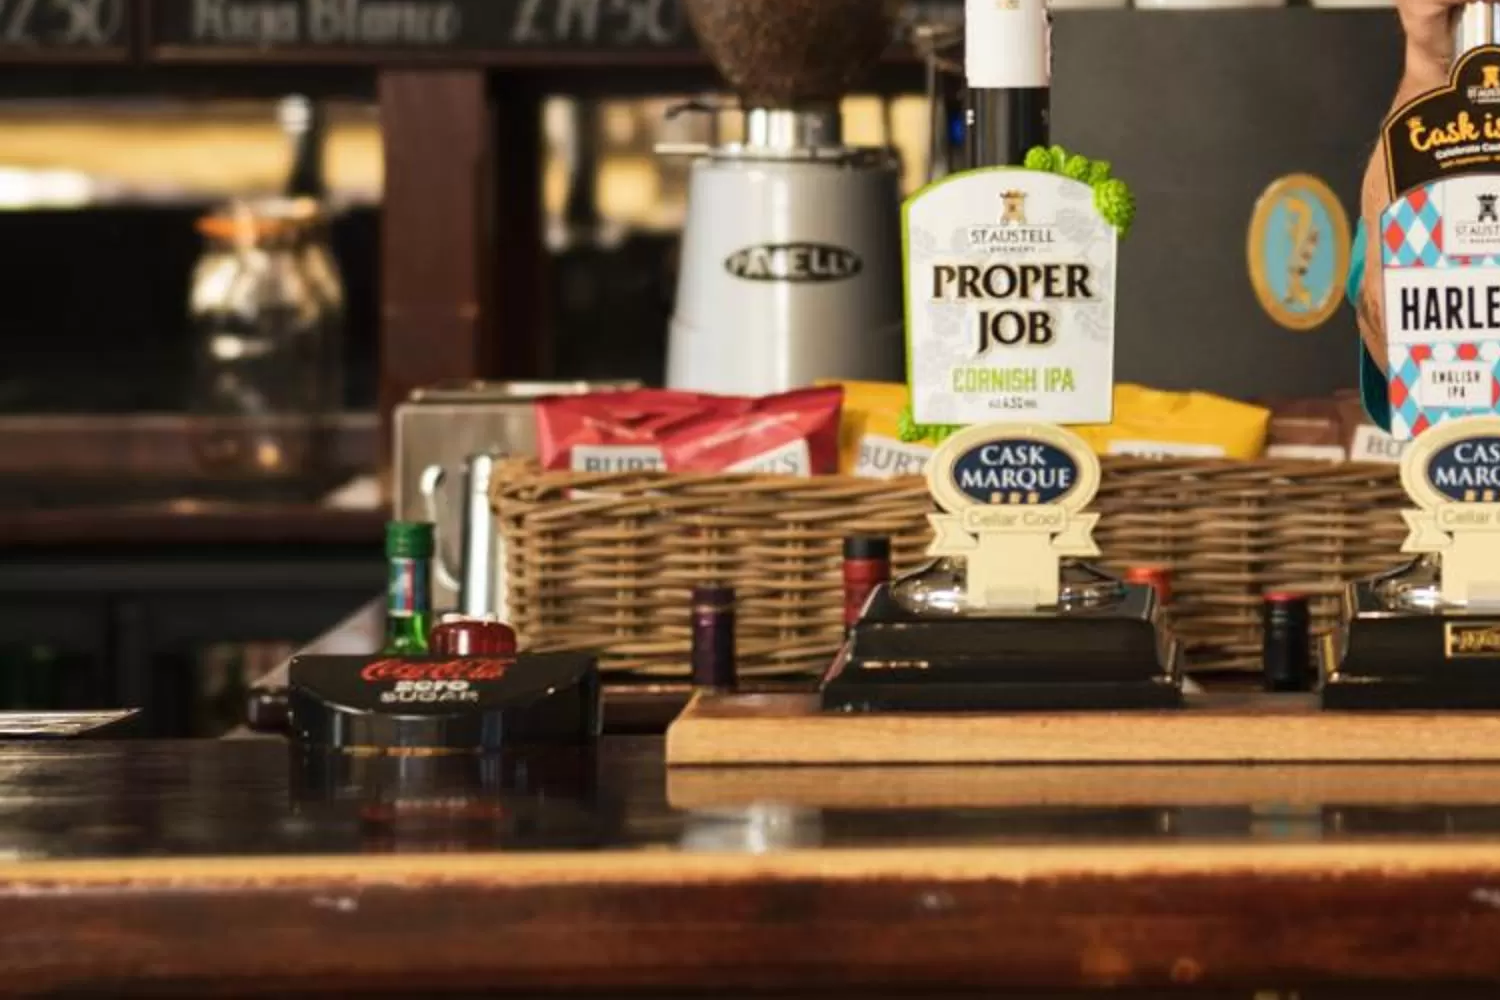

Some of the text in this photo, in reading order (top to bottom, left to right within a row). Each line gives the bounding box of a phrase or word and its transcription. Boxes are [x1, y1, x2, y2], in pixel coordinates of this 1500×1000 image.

[1408, 110, 1480, 152] Cask
[932, 264, 1093, 298] PROPER
[977, 310, 1053, 354] JOB
[952, 367, 1076, 393] CORNISH IPA
[979, 445, 1047, 465] CASK
[961, 468, 1071, 490] MARQUE
[1442, 508, 1491, 525] Cellar
